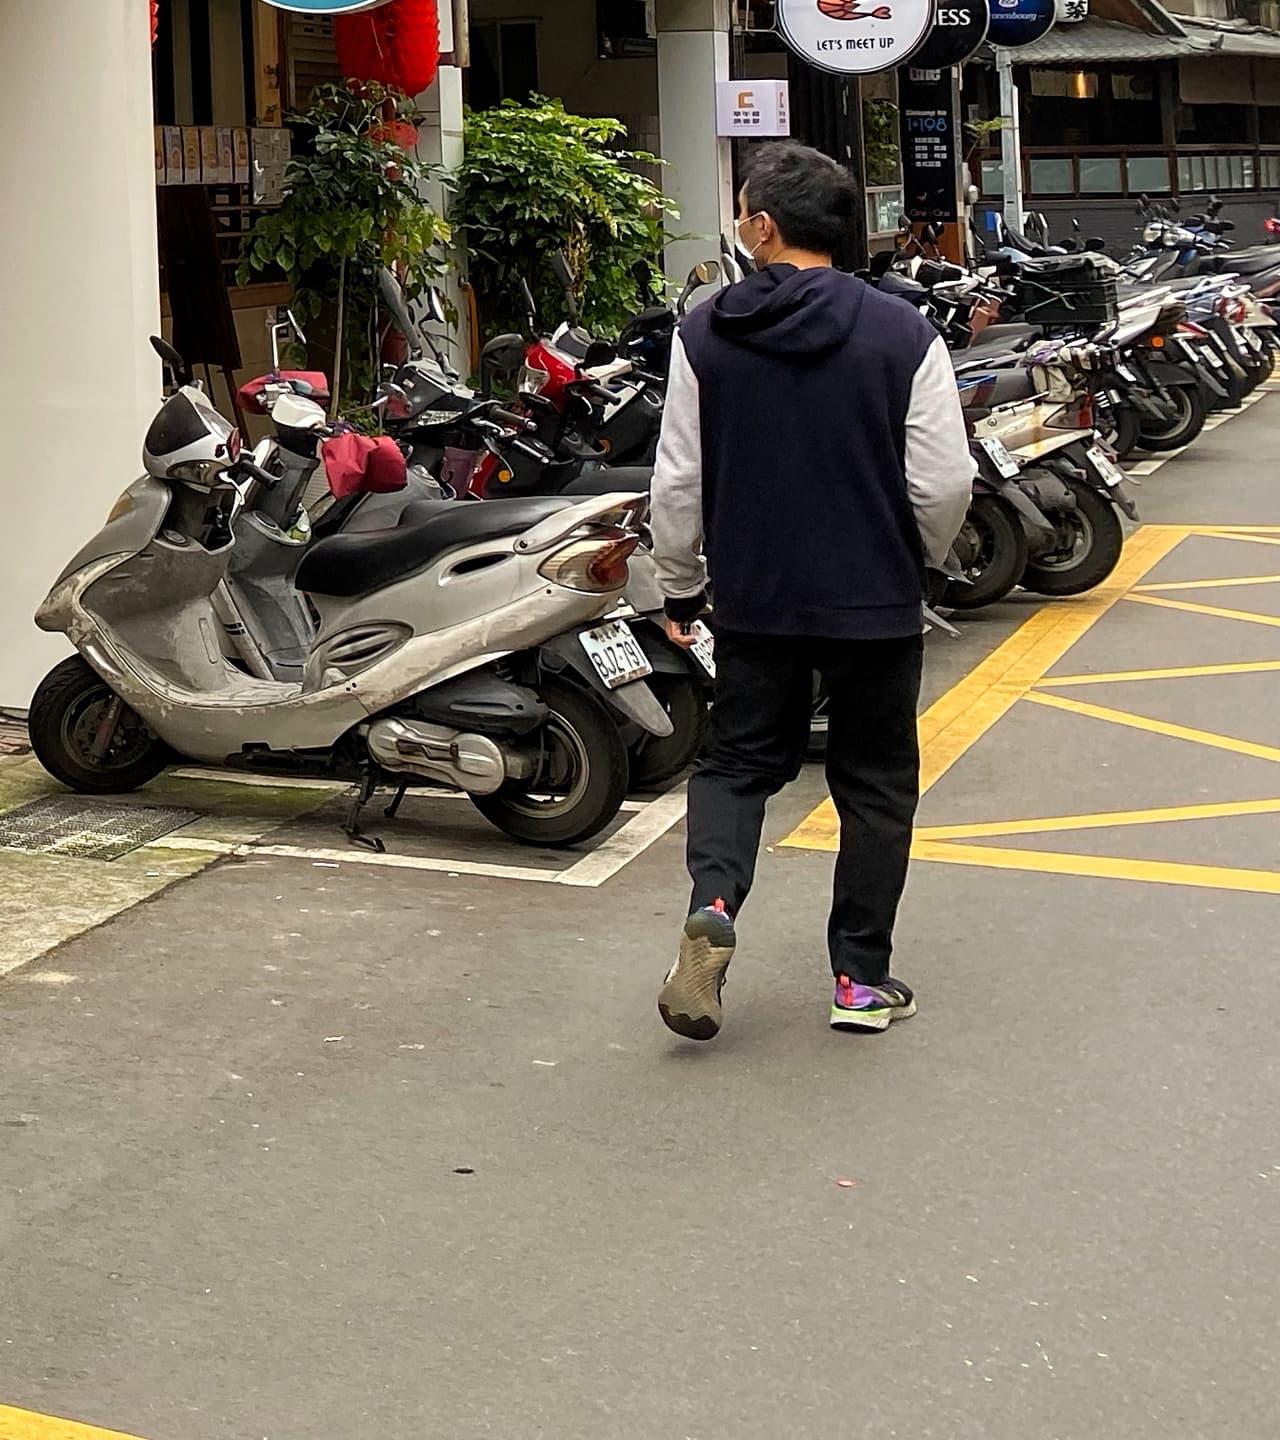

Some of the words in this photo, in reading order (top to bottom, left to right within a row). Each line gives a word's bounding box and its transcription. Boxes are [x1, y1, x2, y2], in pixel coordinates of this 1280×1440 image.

[816, 38, 843, 52] LET'S
[845, 38, 876, 50] MEET
[878, 37, 895, 49] UP
